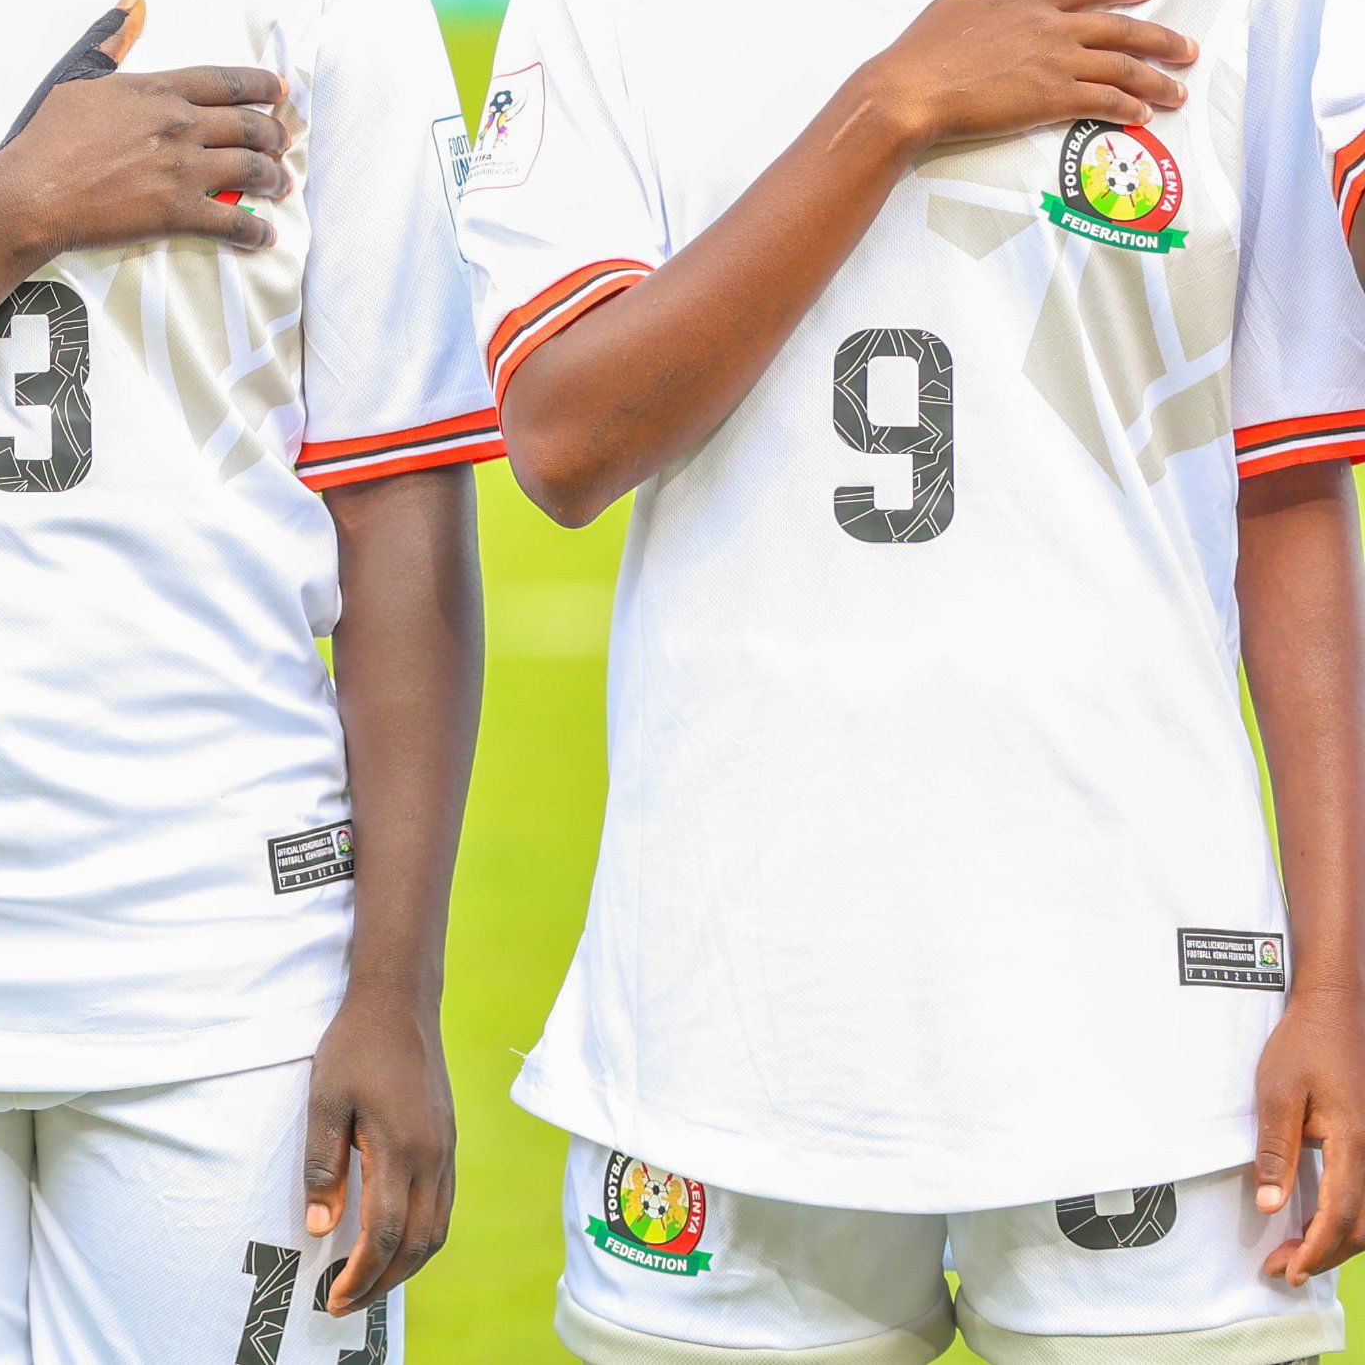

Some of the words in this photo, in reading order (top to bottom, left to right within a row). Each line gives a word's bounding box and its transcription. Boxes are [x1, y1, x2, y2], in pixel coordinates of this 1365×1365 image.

[1064, 120, 1100, 198] FOOTBALL
[1159, 158, 1178, 213] KENYA
[1061, 213, 1158, 249] FEDERATION
[833, 328, 955, 543] 9
[1186, 940, 1208, 949] OFFICIAL
[1186, 950, 1212, 959] FOOTBALL
[604, 1236, 687, 1271] FEDERATION
